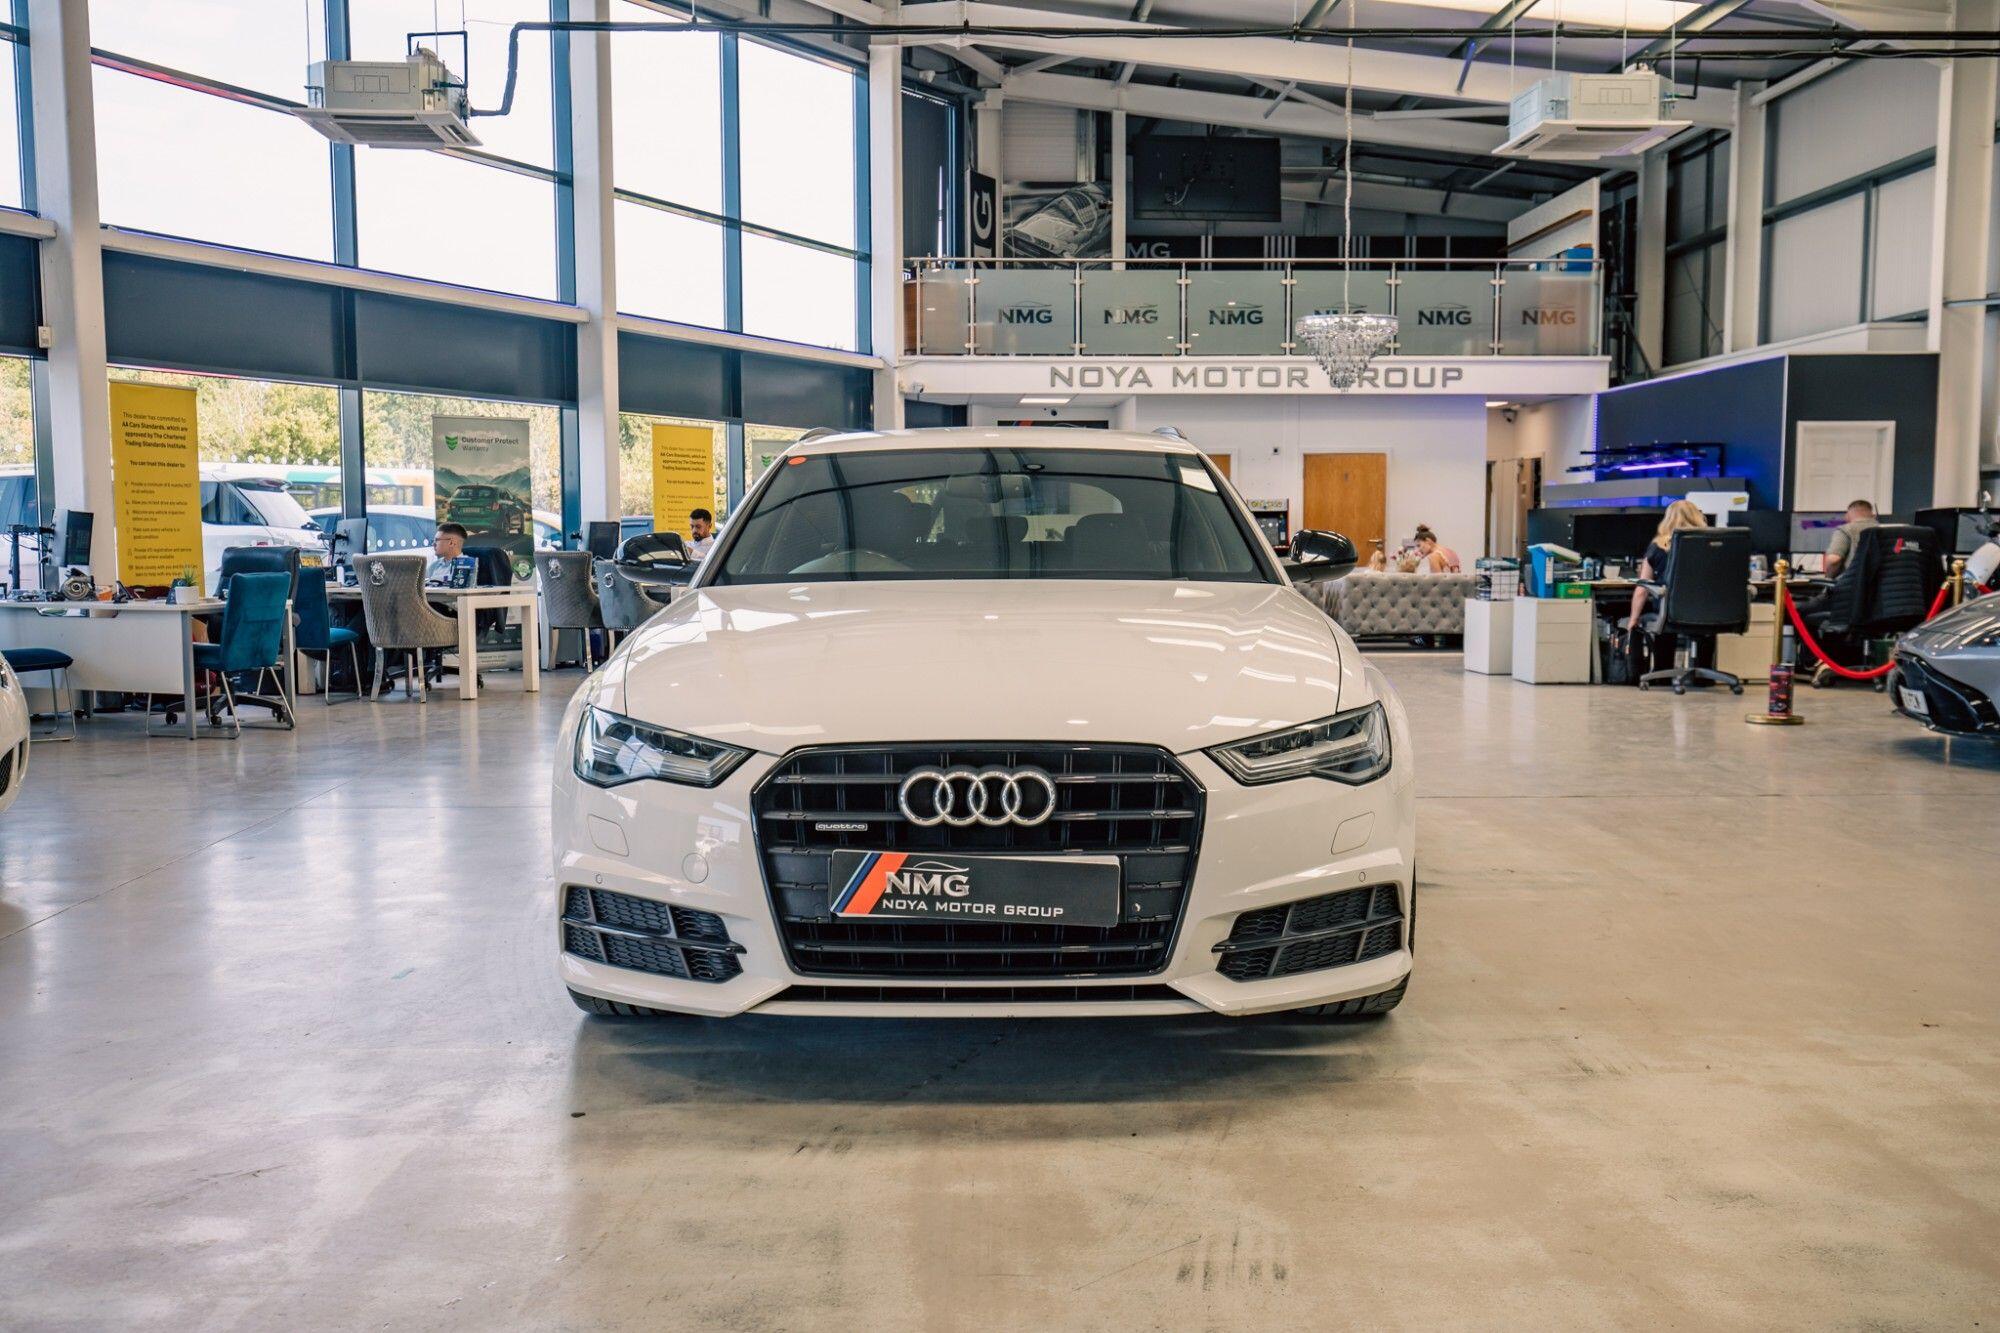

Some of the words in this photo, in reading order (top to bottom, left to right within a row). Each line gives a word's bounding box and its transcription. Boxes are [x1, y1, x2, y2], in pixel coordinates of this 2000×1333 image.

[998, 309, 1053, 324] NMG
[1104, 309, 1158, 325] NMG
[1209, 310, 1264, 325] NMG
[1418, 310, 1472, 325] NMG
[1522, 310, 1576, 325] NMG
[1050, 366, 1153, 387] NOYA
[1172, 366, 1309, 388] MOTOR
[495, 437, 519, 445] Protect
[885, 871, 970, 898] NMG
[882, 899, 928, 911] NOYA
[935, 902, 996, 914] MOTOR
[1003, 905, 1064, 918] GROUP
